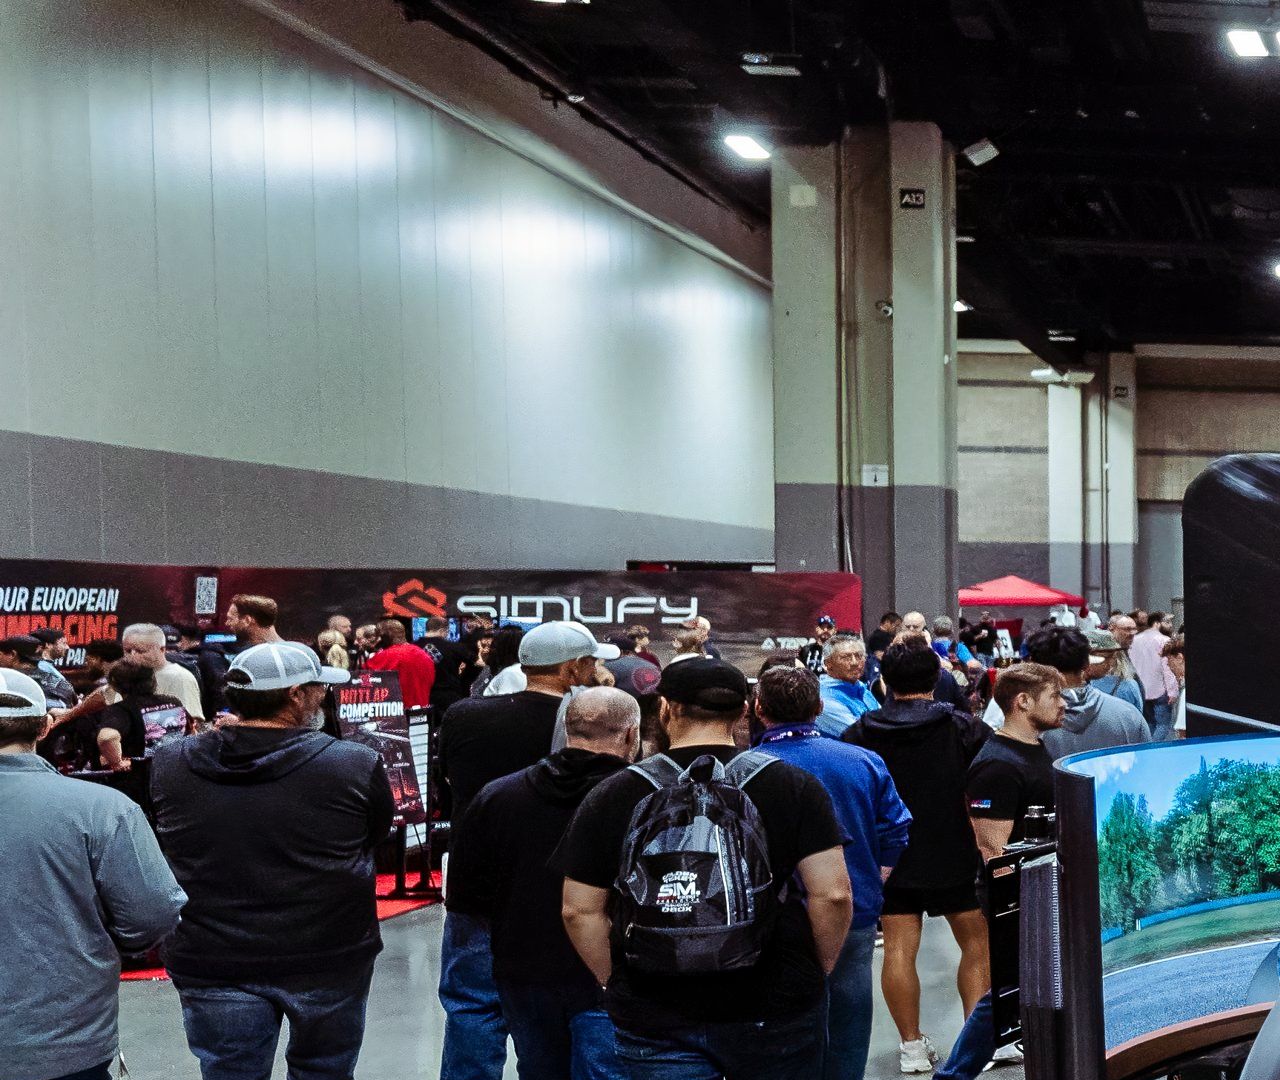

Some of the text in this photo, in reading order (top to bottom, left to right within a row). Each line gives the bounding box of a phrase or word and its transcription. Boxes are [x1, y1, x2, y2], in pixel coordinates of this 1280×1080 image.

[31, 588, 119, 612] EUROPEAN
[457, 595, 698, 623] SIMUFY
[340, 701, 404, 719] COMPETITION
